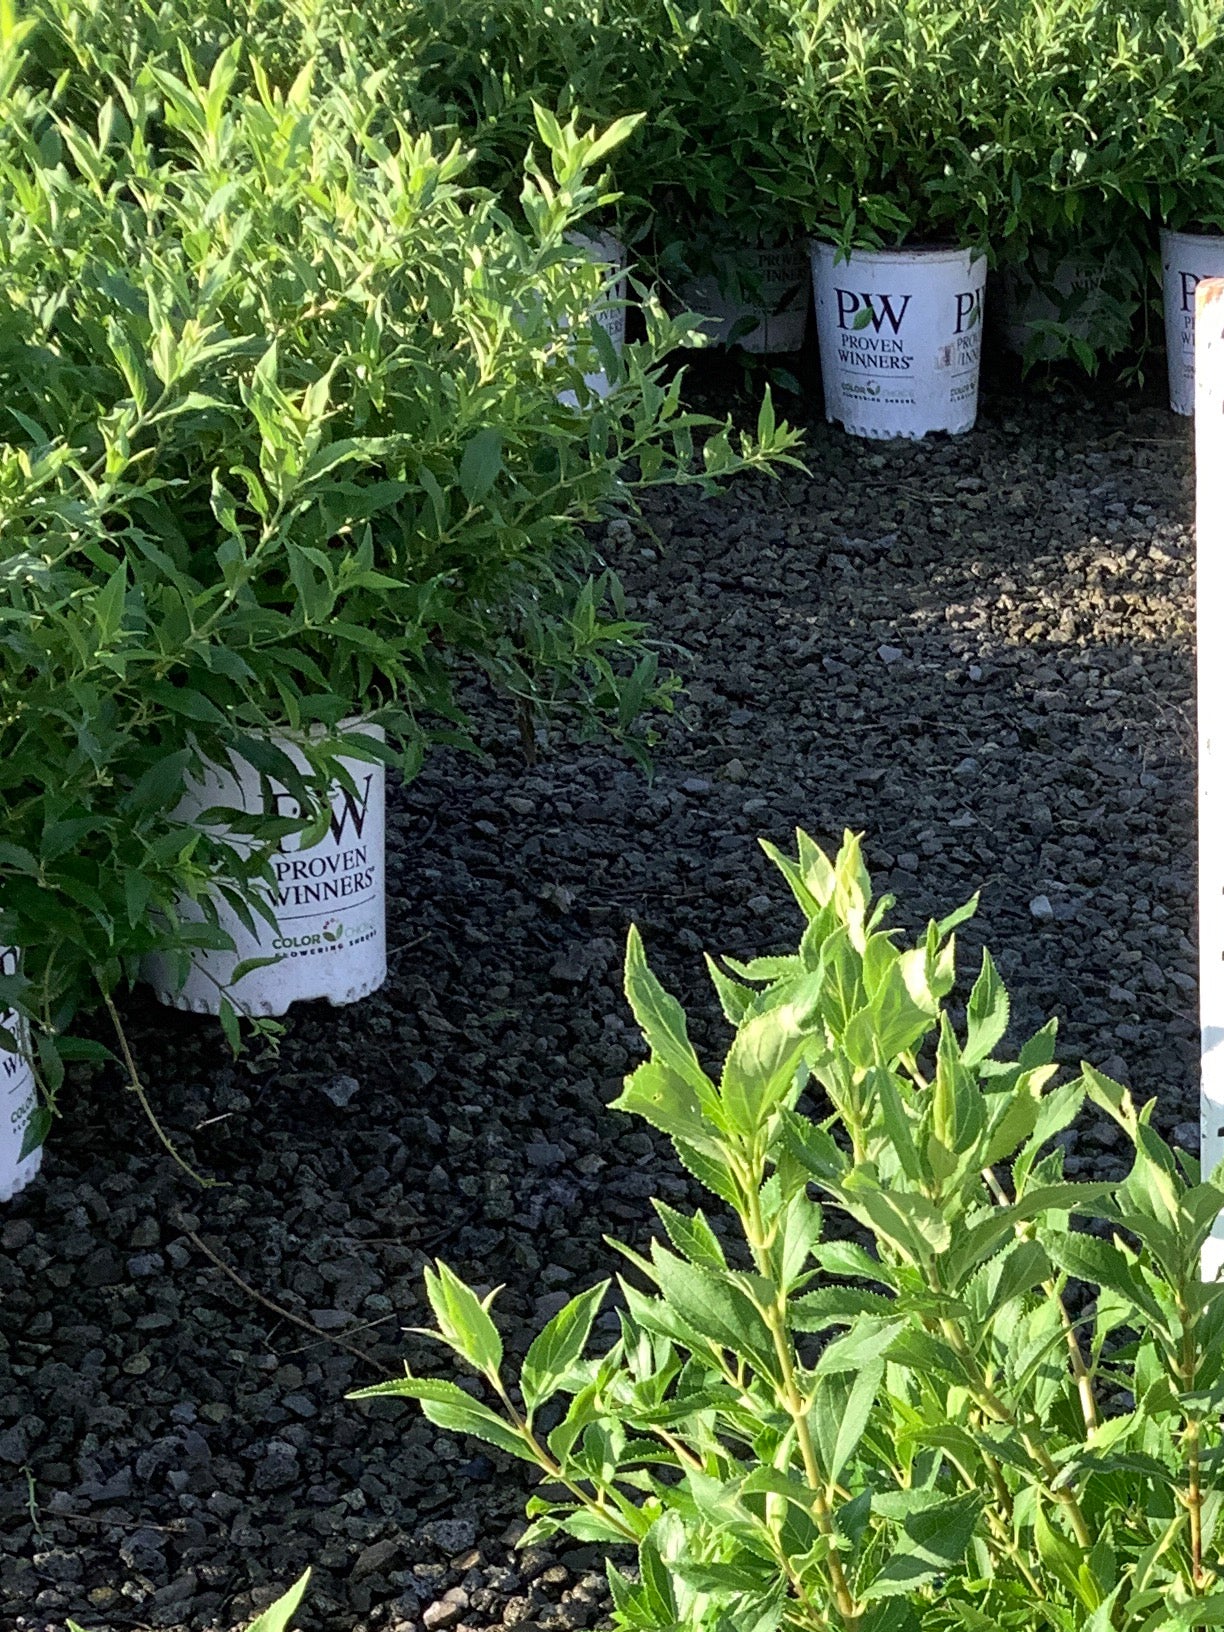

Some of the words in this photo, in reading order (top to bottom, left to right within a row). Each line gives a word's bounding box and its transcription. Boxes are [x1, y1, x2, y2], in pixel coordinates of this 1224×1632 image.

[833, 287, 912, 335] PW
[841, 333, 904, 353] PROVEN
[276, 845, 368, 882] PROVEN
[272, 933, 320, 949] COLOR
